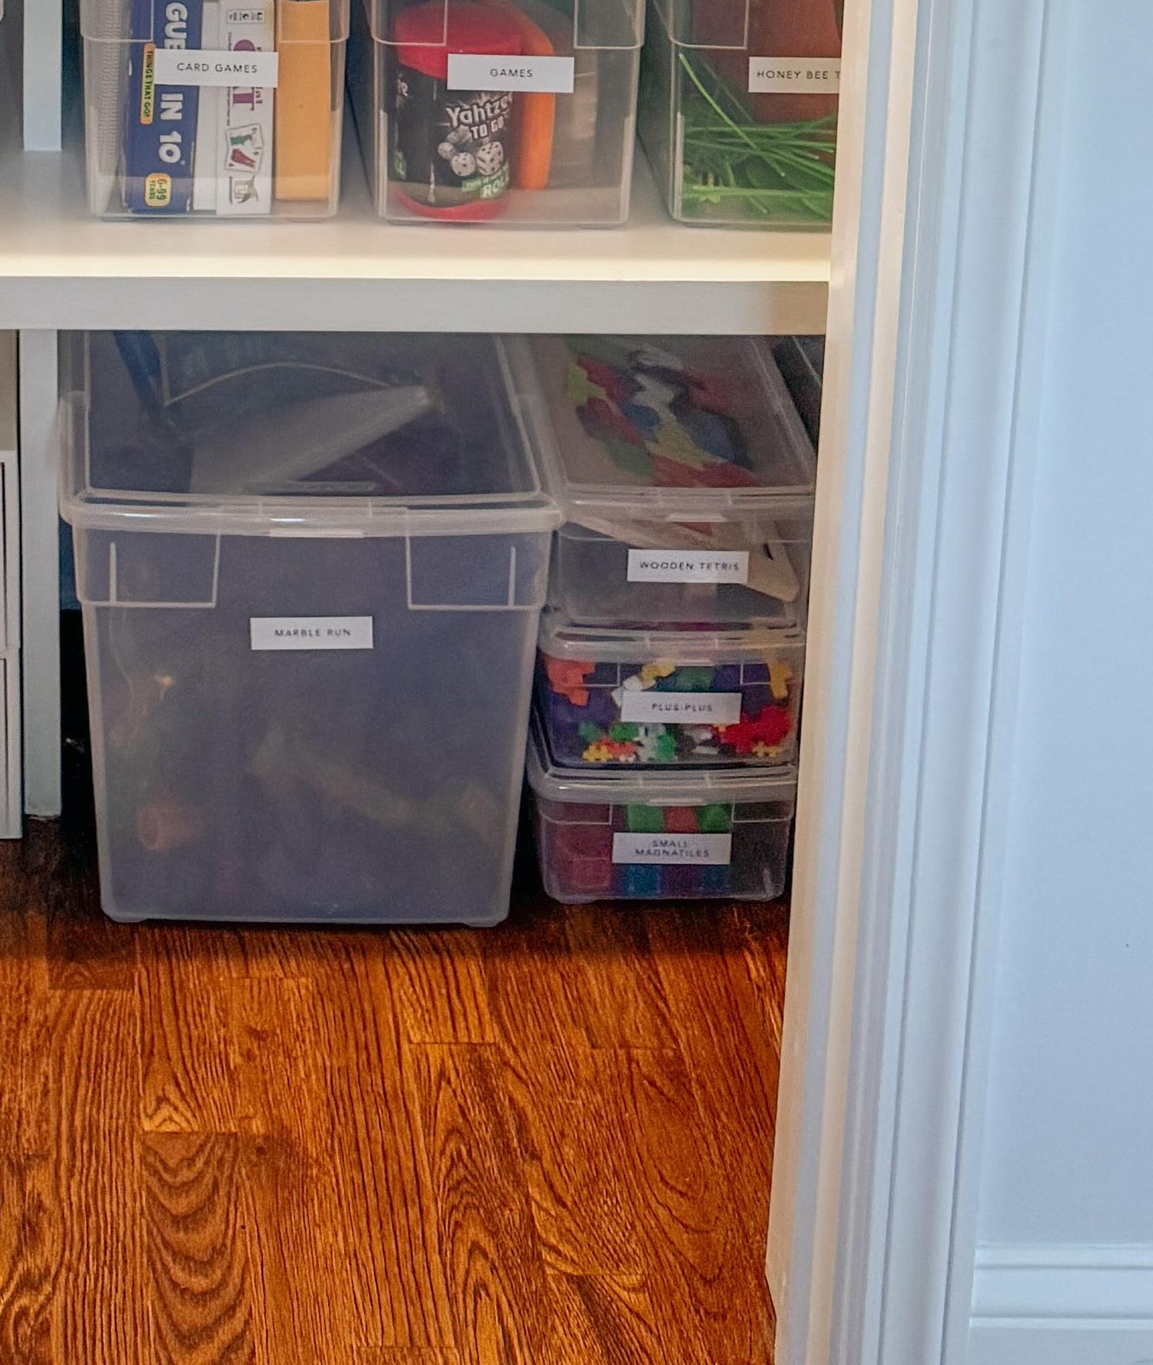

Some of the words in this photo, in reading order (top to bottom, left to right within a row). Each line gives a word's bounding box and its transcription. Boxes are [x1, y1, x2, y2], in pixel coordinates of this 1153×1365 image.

[176, 62, 210, 72] CARD
[215, 63, 258, 73] GAMES
[757, 70, 800, 80] HONEY
[805, 70, 829, 80] BEE
[160, 93, 183, 120] IN
[158, 131, 181, 164] 10
[639, 561, 695, 571] WOODEN
[698, 561, 740, 571] TETRIS
[274, 628, 322, 638] MARBLE
[326, 628, 352, 637] RUN
